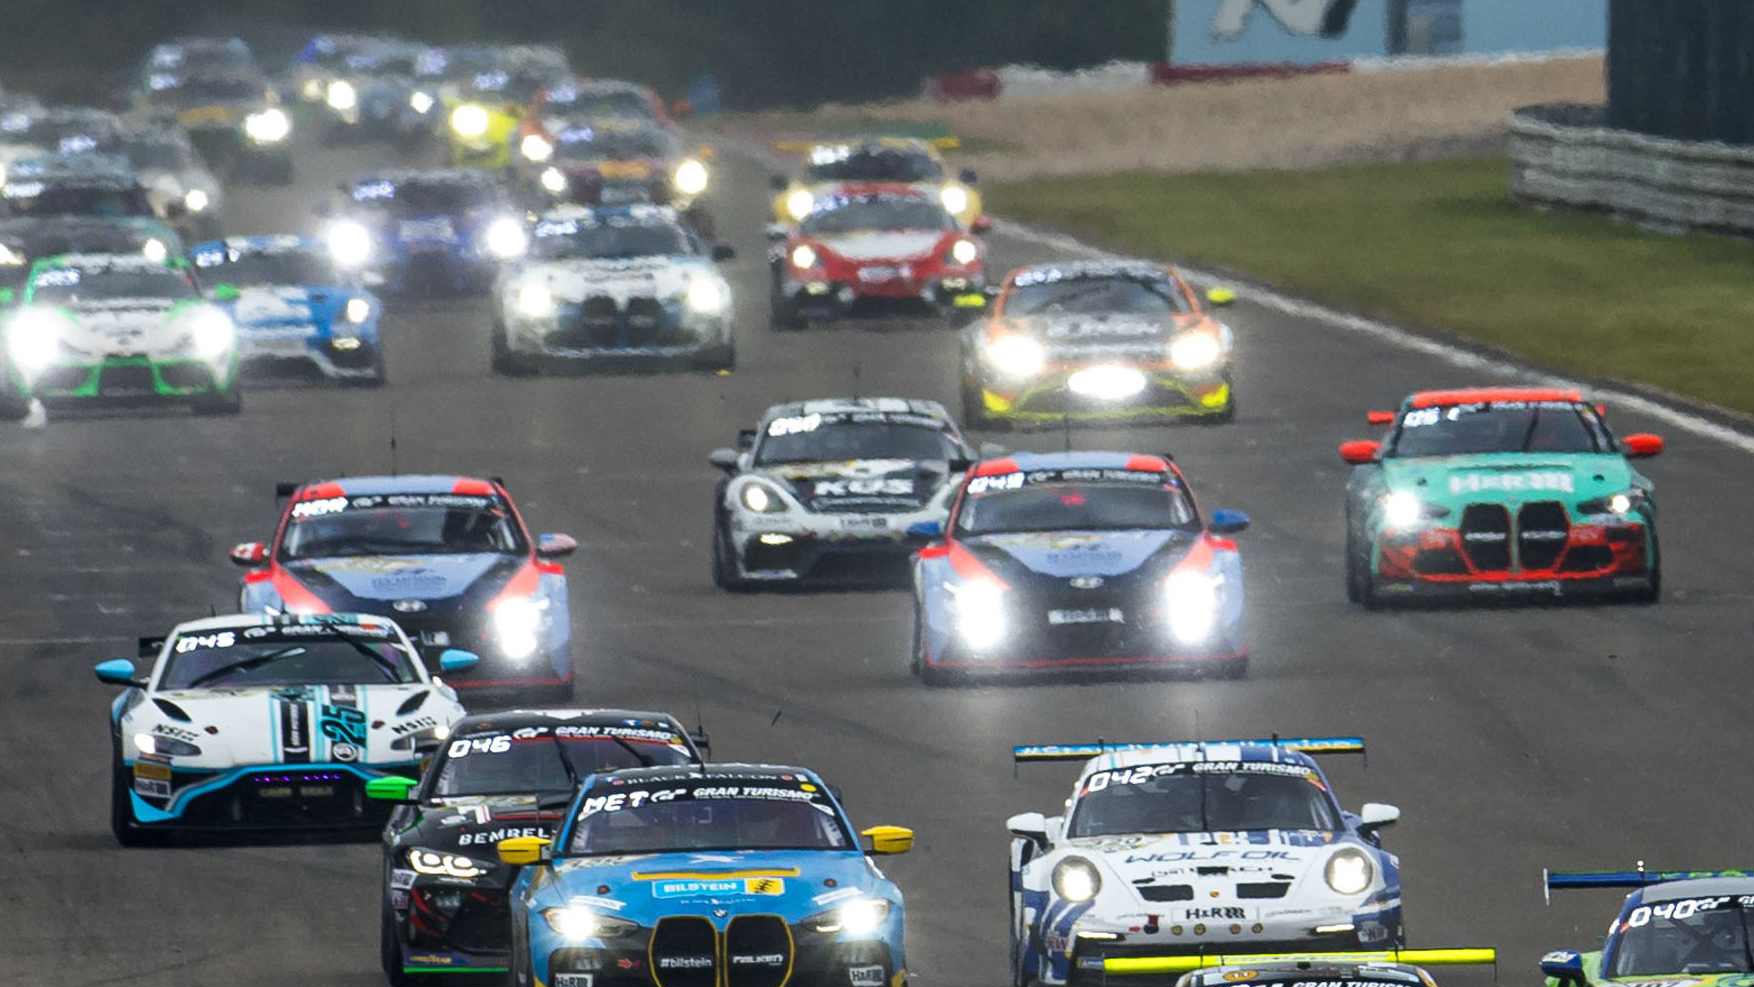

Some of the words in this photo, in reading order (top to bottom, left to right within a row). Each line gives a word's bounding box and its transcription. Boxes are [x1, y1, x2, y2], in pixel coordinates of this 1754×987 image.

[555, 726, 606, 737] GRAN
[448, 735, 512, 759] 046
[1087, 765, 1151, 792] 042
[692, 787, 740, 798] GRAN
[741, 787, 814, 801] TURISMO
[663, 882, 738, 893] BILSTEIN
[660, 957, 712, 968] #bilstein
